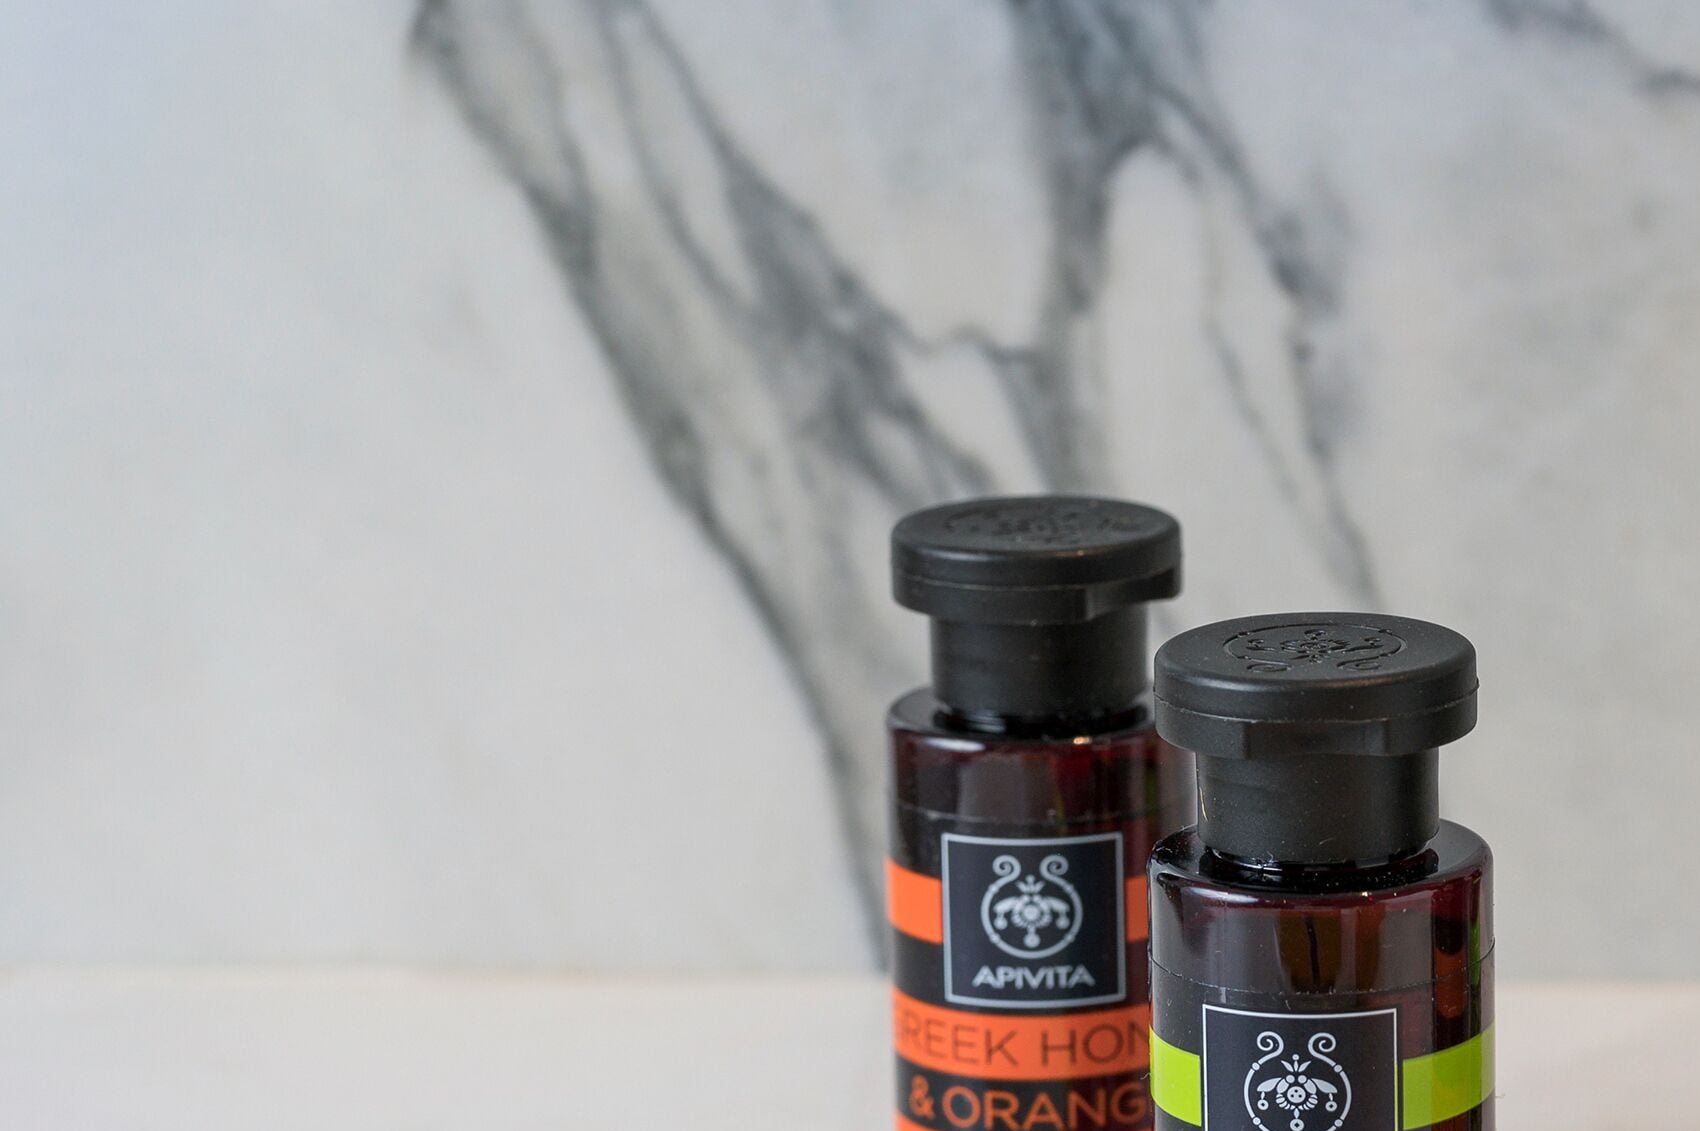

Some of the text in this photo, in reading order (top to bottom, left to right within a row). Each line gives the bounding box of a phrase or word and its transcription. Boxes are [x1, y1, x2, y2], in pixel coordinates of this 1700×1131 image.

[971, 965, 1096, 989] APIVITA
[896, 1005, 1150, 1068] REEK HON
[907, 1075, 935, 1120] &
